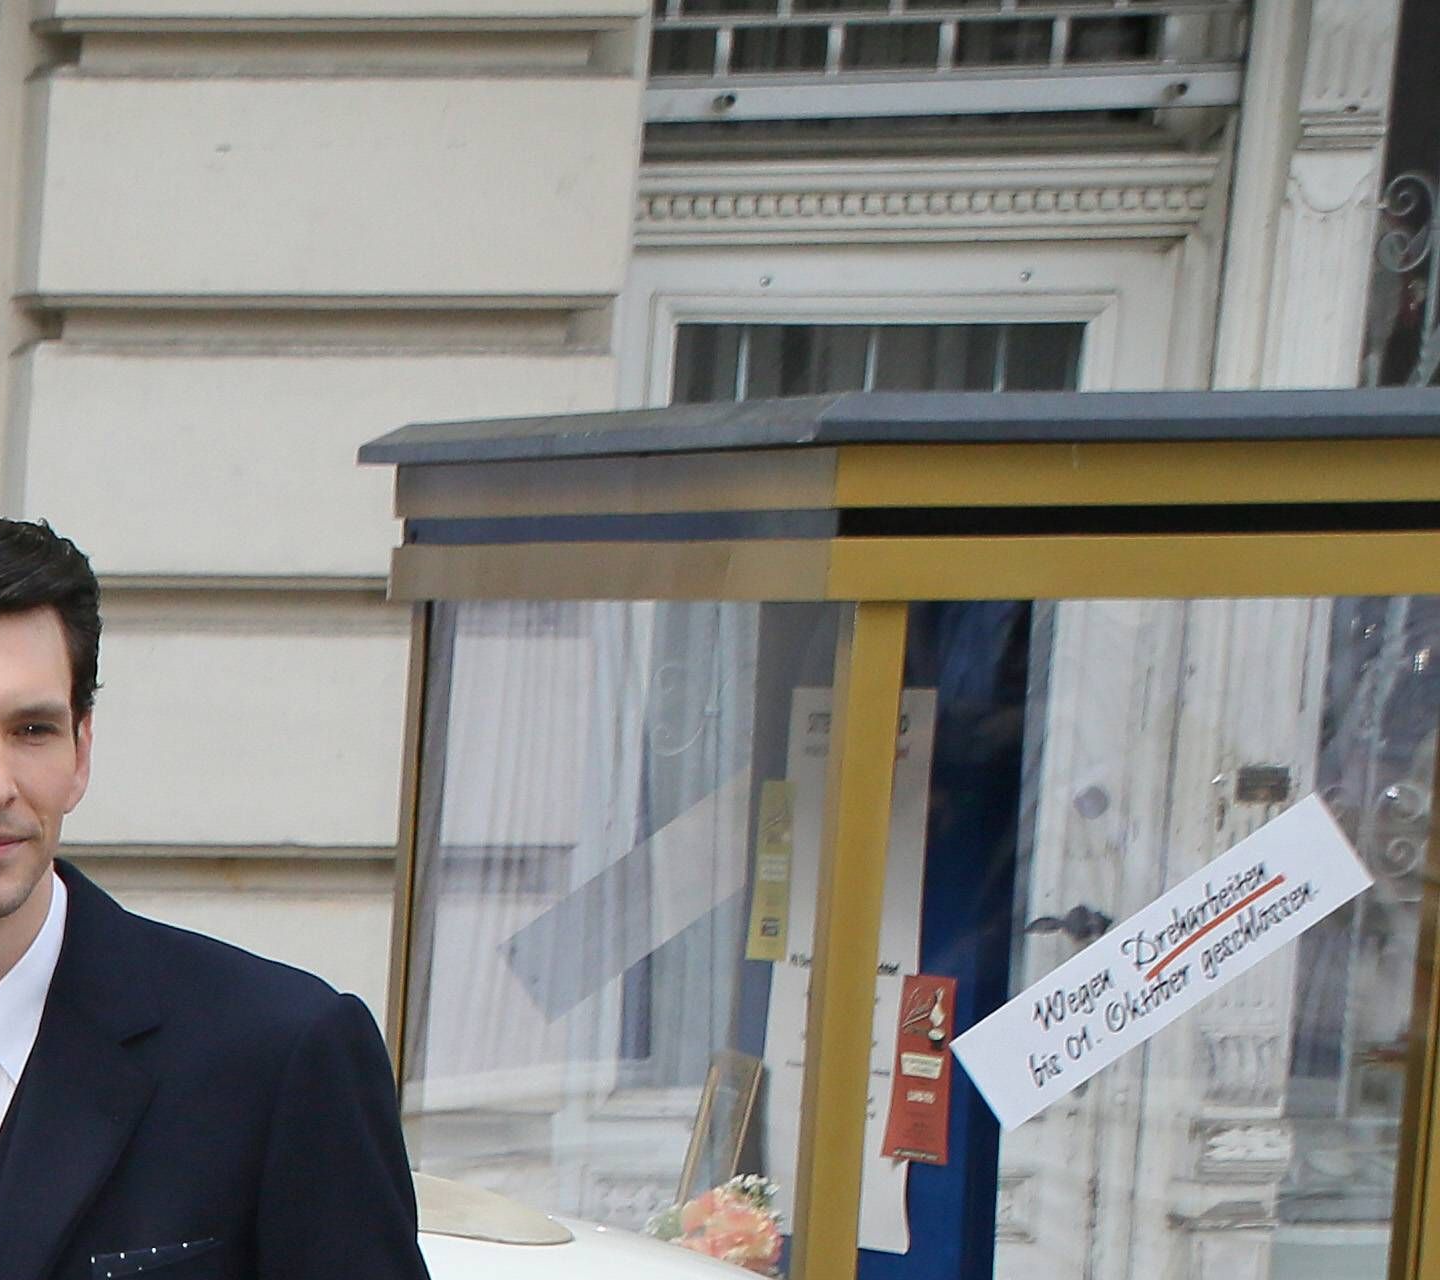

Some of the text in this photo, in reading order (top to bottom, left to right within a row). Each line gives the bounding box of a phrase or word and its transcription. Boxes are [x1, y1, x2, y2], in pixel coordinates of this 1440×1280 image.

[1032, 861, 1265, 1031] Wegen Dreharbeiten
[1029, 1053, 1063, 1088] bis
[1105, 963, 1191, 1032] Oktober
